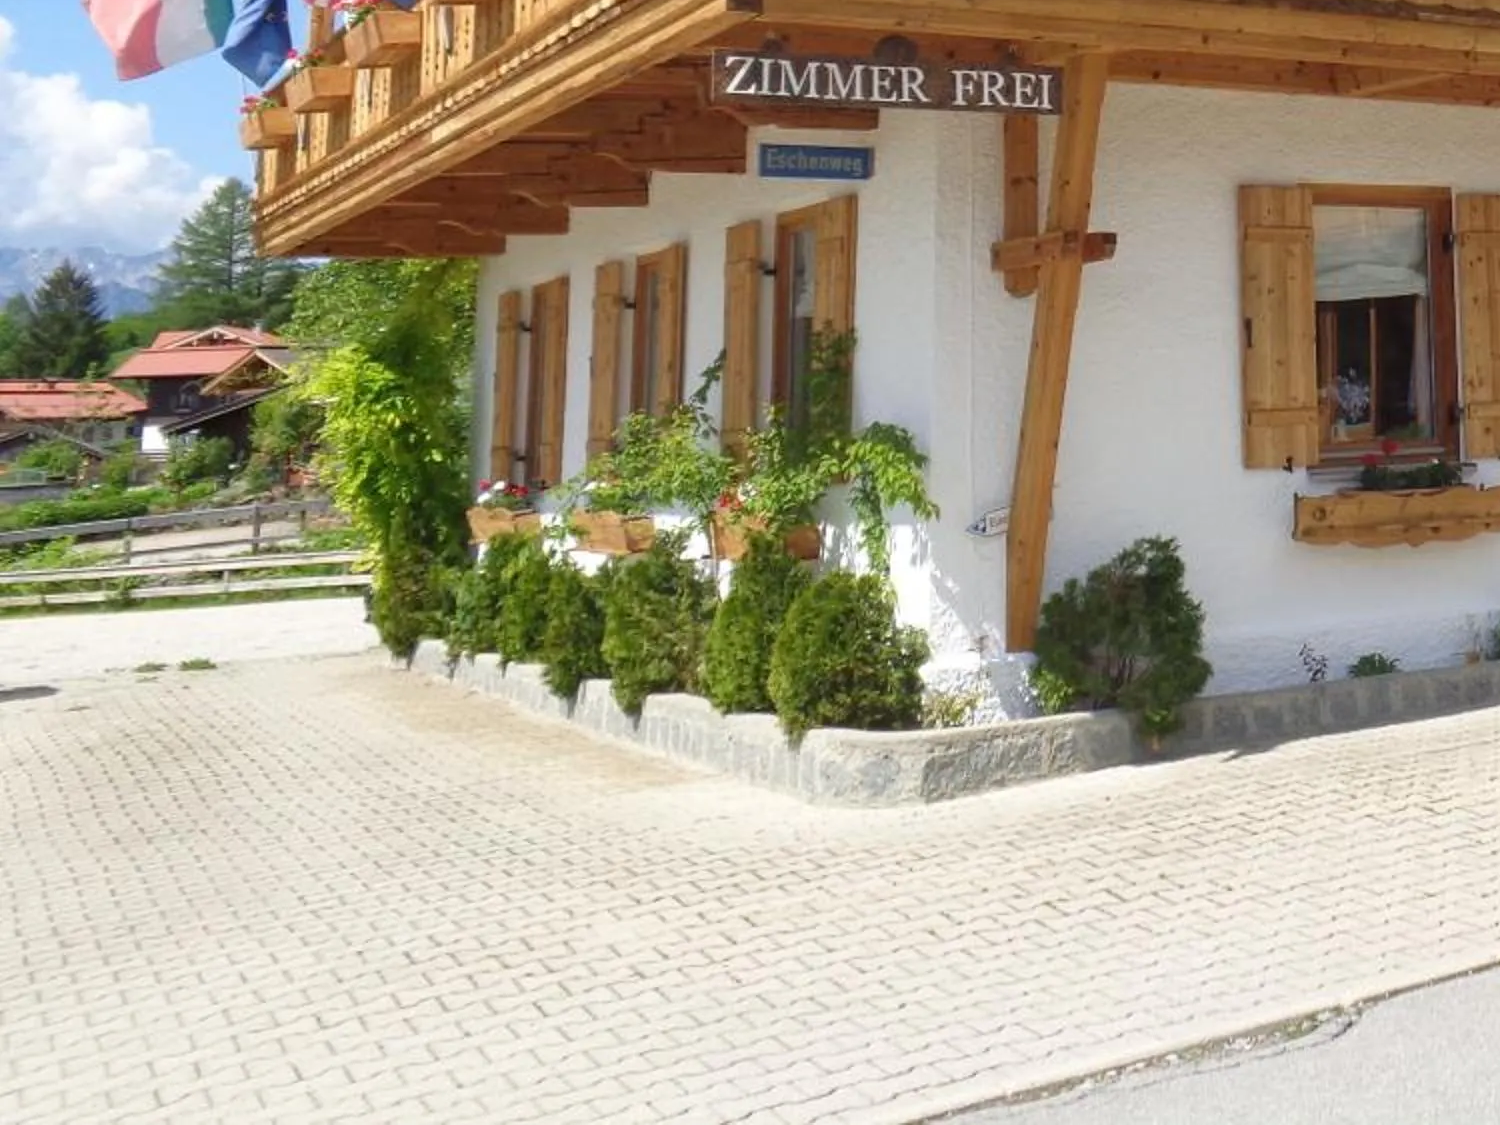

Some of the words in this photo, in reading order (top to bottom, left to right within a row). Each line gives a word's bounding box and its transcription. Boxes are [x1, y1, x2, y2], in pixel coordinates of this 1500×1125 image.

[724, 55, 931, 104] ZIMMER
[950, 69, 1054, 110] FREI
[766, 147, 864, 176] Eschenweg
